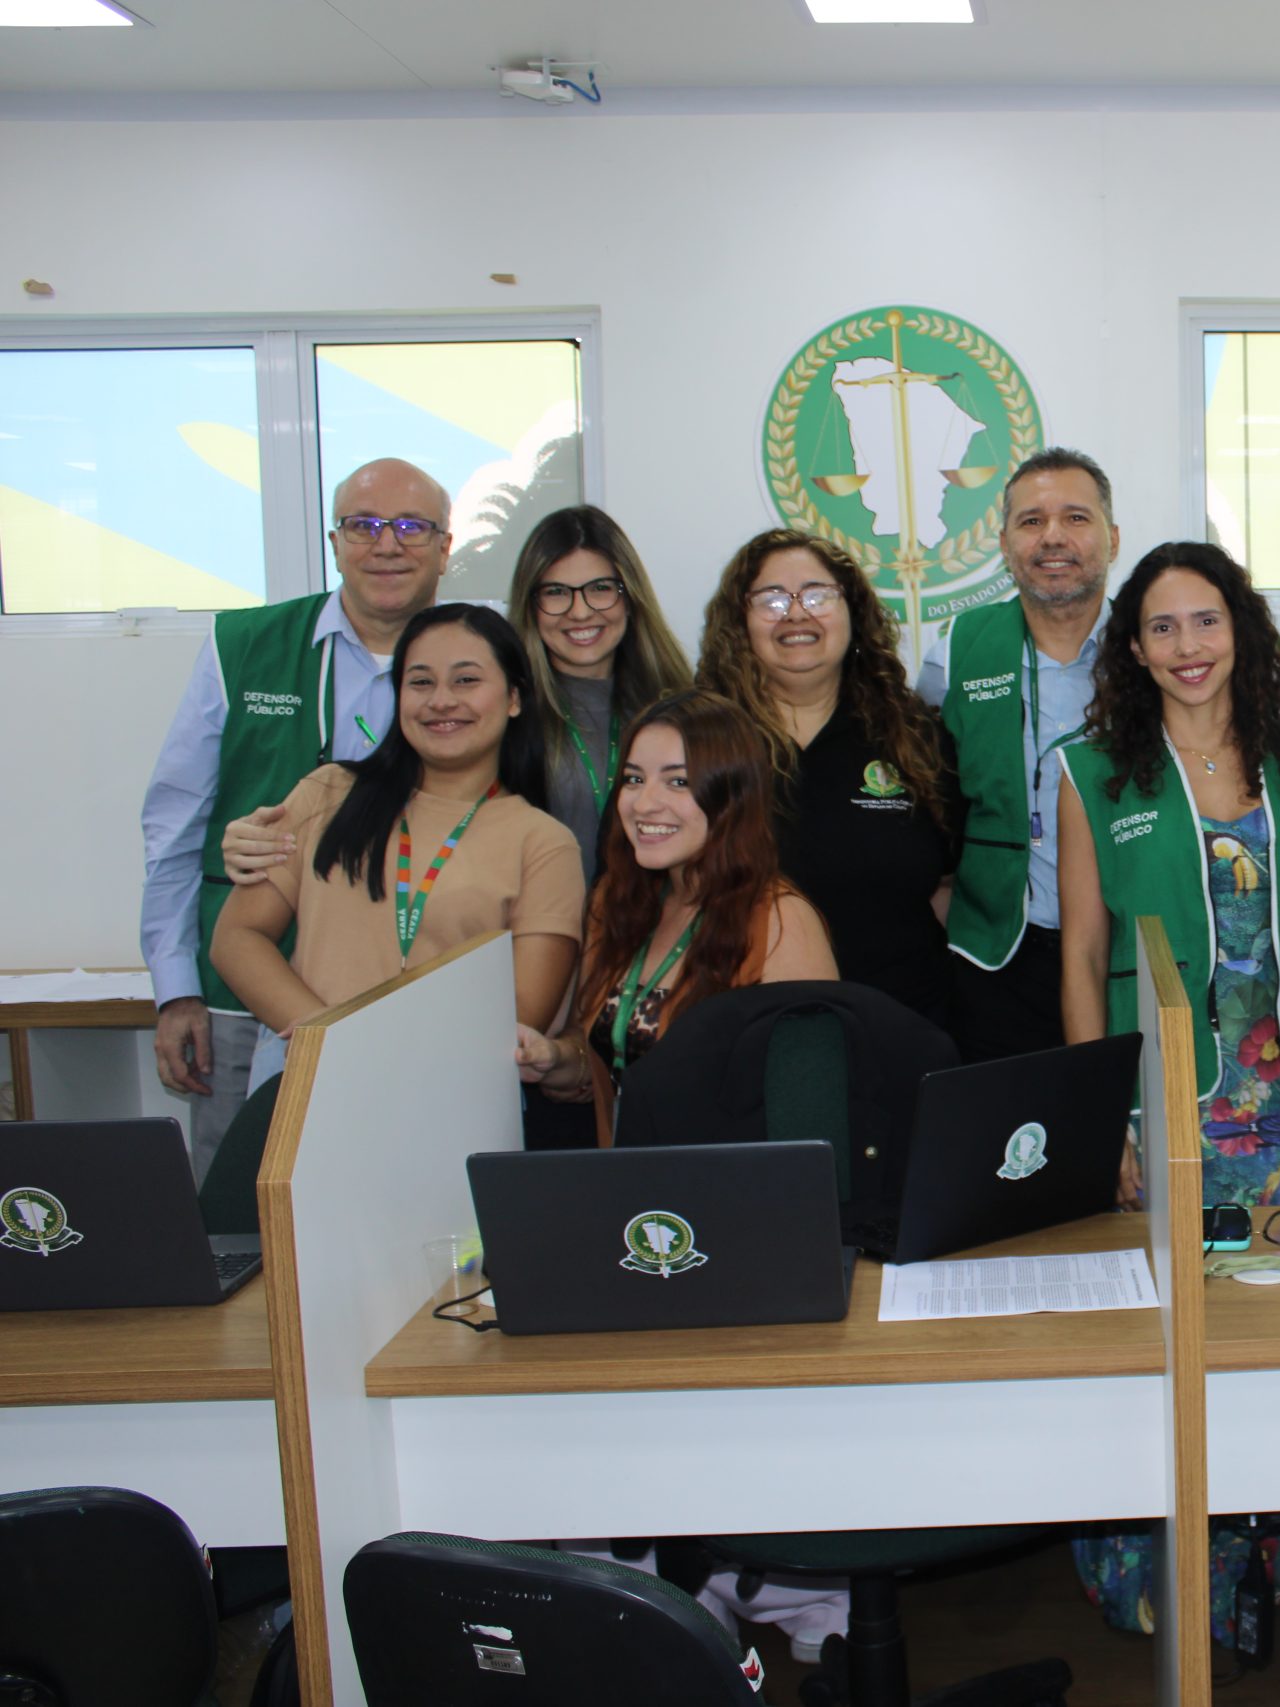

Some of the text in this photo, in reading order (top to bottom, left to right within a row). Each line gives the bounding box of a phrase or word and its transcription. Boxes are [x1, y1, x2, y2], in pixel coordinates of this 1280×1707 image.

[928, 604, 947, 617] DO
[949, 586, 996, 612] ESTADO
[963, 672, 1015, 691] DEFENSOR
[244, 691, 302, 706] DEFENSOR
[969, 687, 1011, 702] PÚBLICO
[247, 702, 294, 715] PÚBLICO
